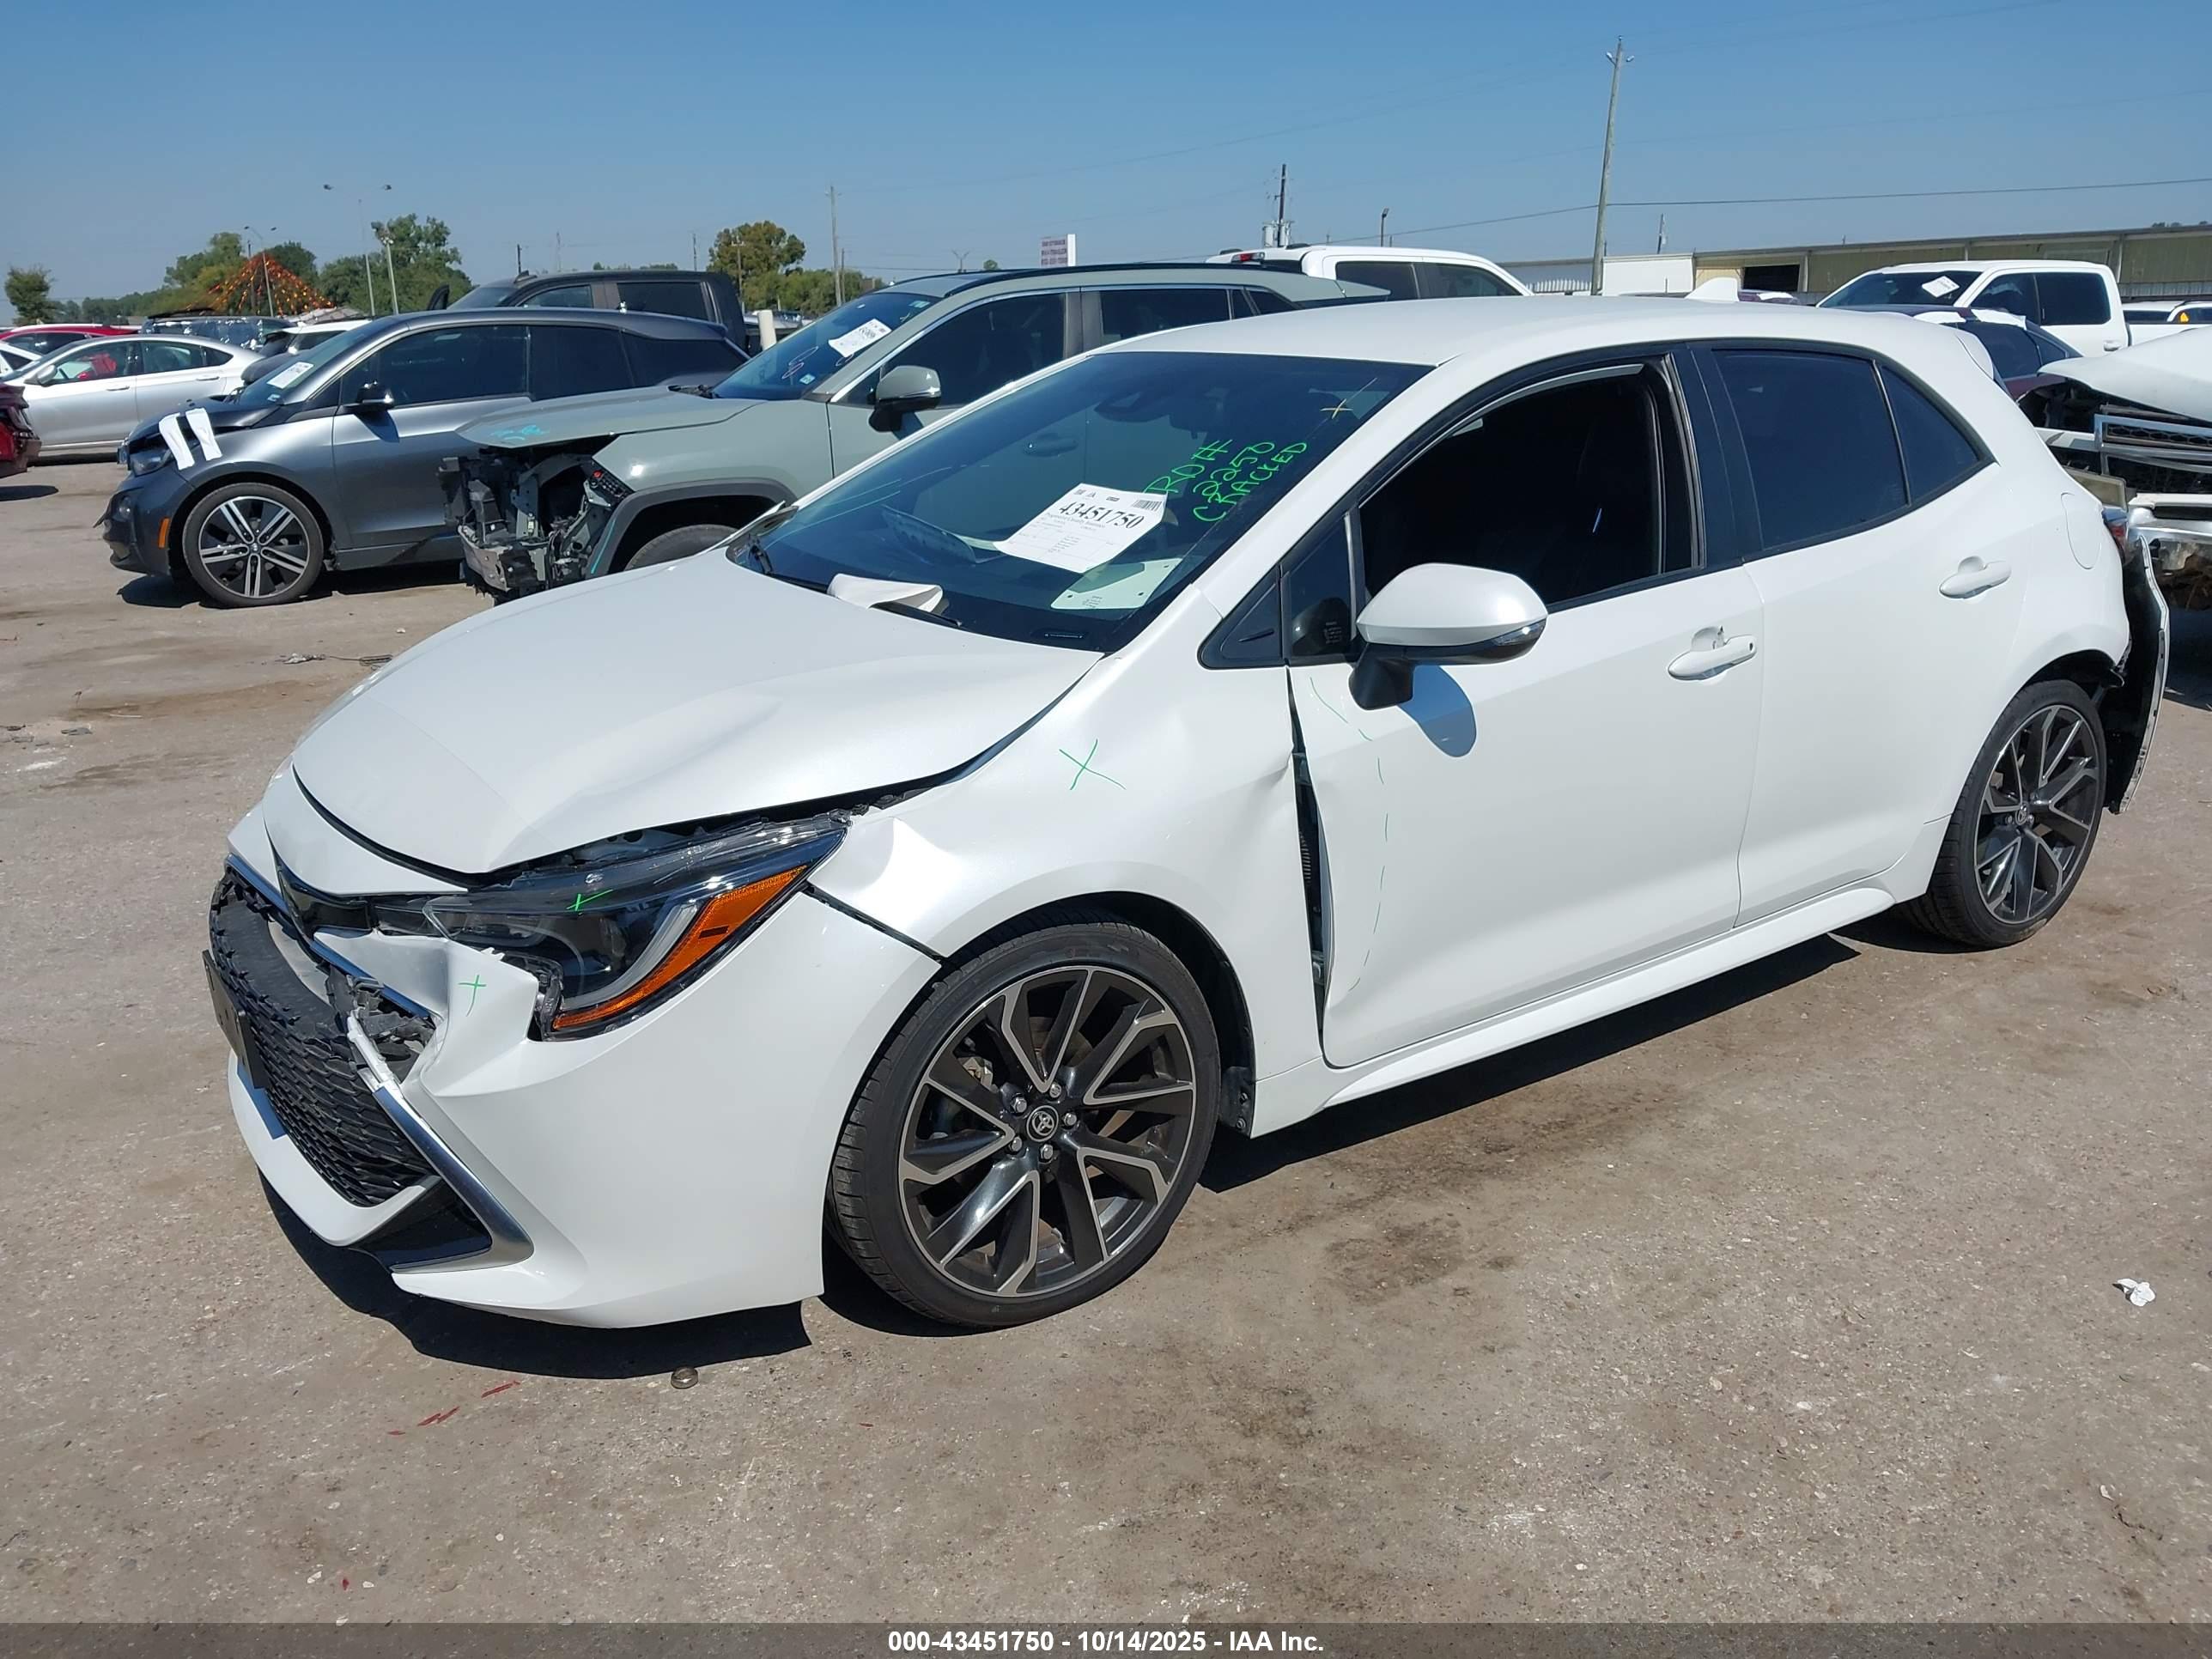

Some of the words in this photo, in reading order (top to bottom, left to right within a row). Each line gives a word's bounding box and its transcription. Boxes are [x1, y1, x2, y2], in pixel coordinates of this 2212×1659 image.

[1143, 439, 1233, 494] RO#
[1192, 441, 1276, 496] 2250
[1193, 441, 1307, 522] CRACKED
[1058, 501, 1146, 530] 43451750
